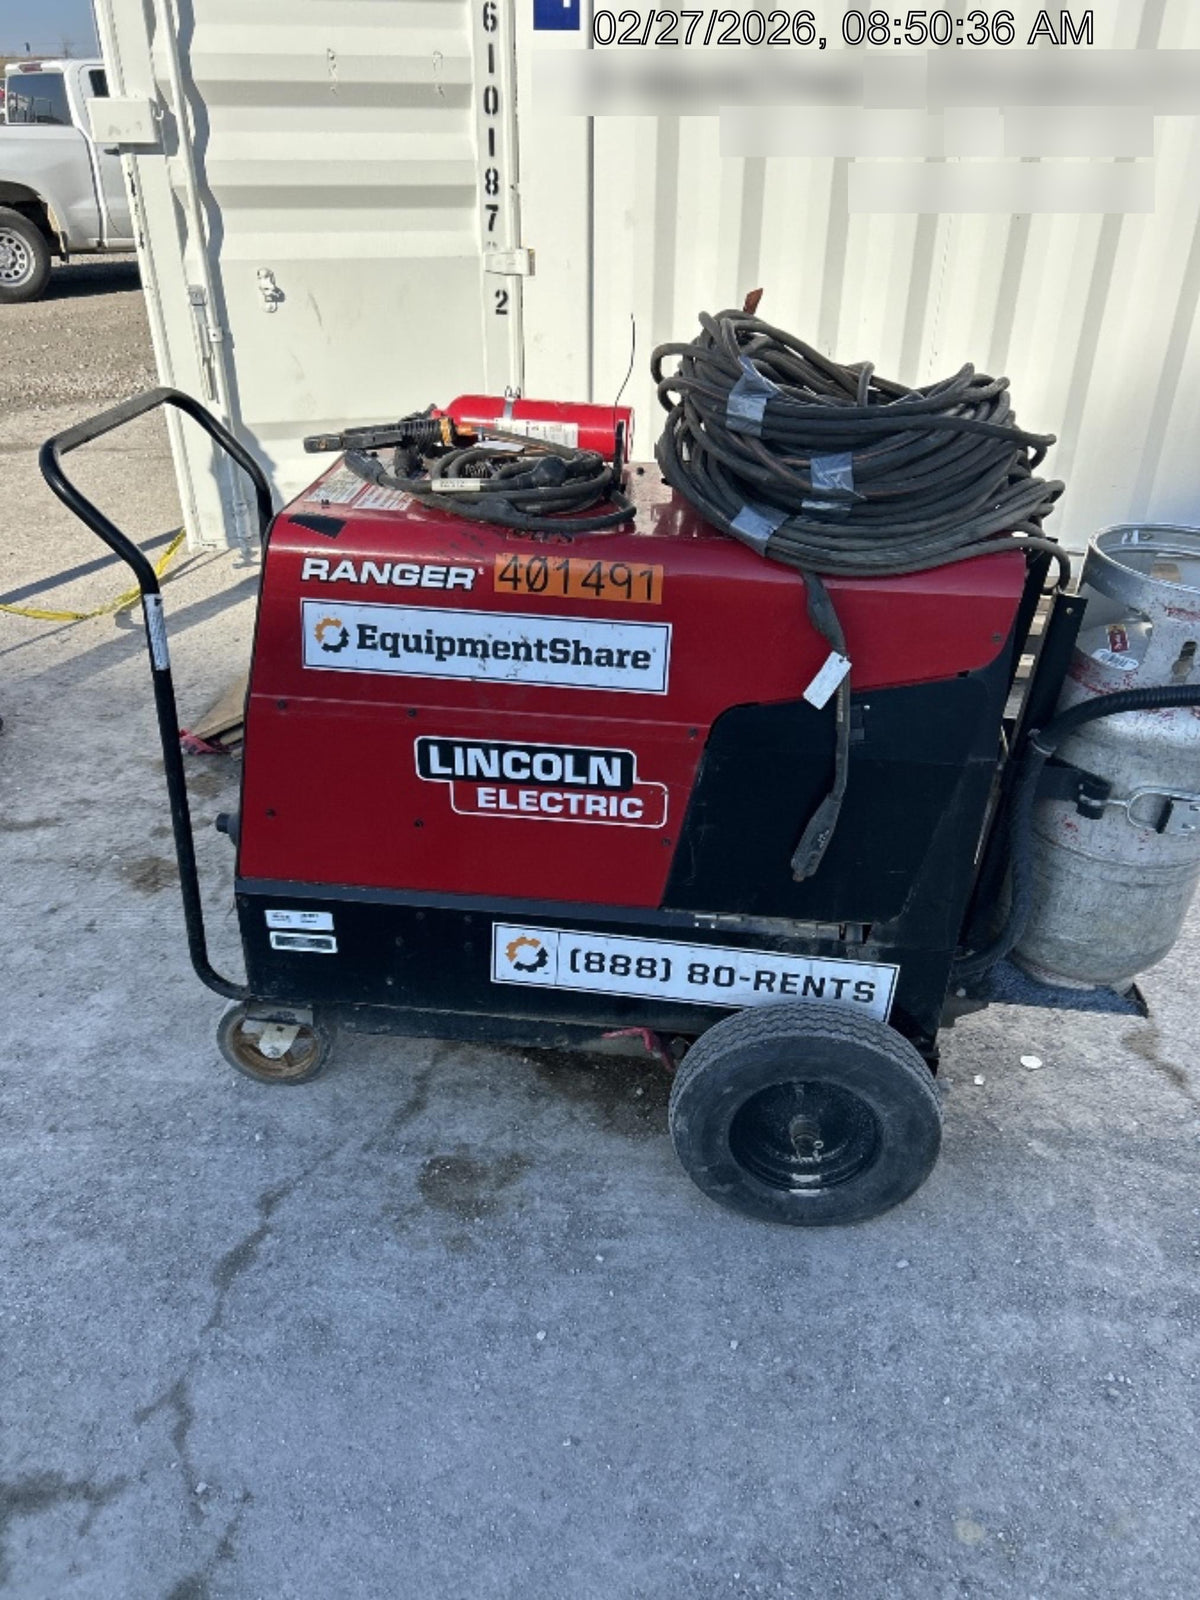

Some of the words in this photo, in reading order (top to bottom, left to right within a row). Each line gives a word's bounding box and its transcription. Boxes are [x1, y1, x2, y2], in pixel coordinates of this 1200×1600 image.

[301, 557, 477, 590] RANGER
[498, 555, 654, 601] 401491
[356, 624, 653, 671] EquipmentShare
[428, 745, 622, 787] LINCOLN
[476, 786, 644, 819] ELECTRIC
[569, 948, 671, 982] (888)
[687, 963, 876, 1003] 80-RENTS
